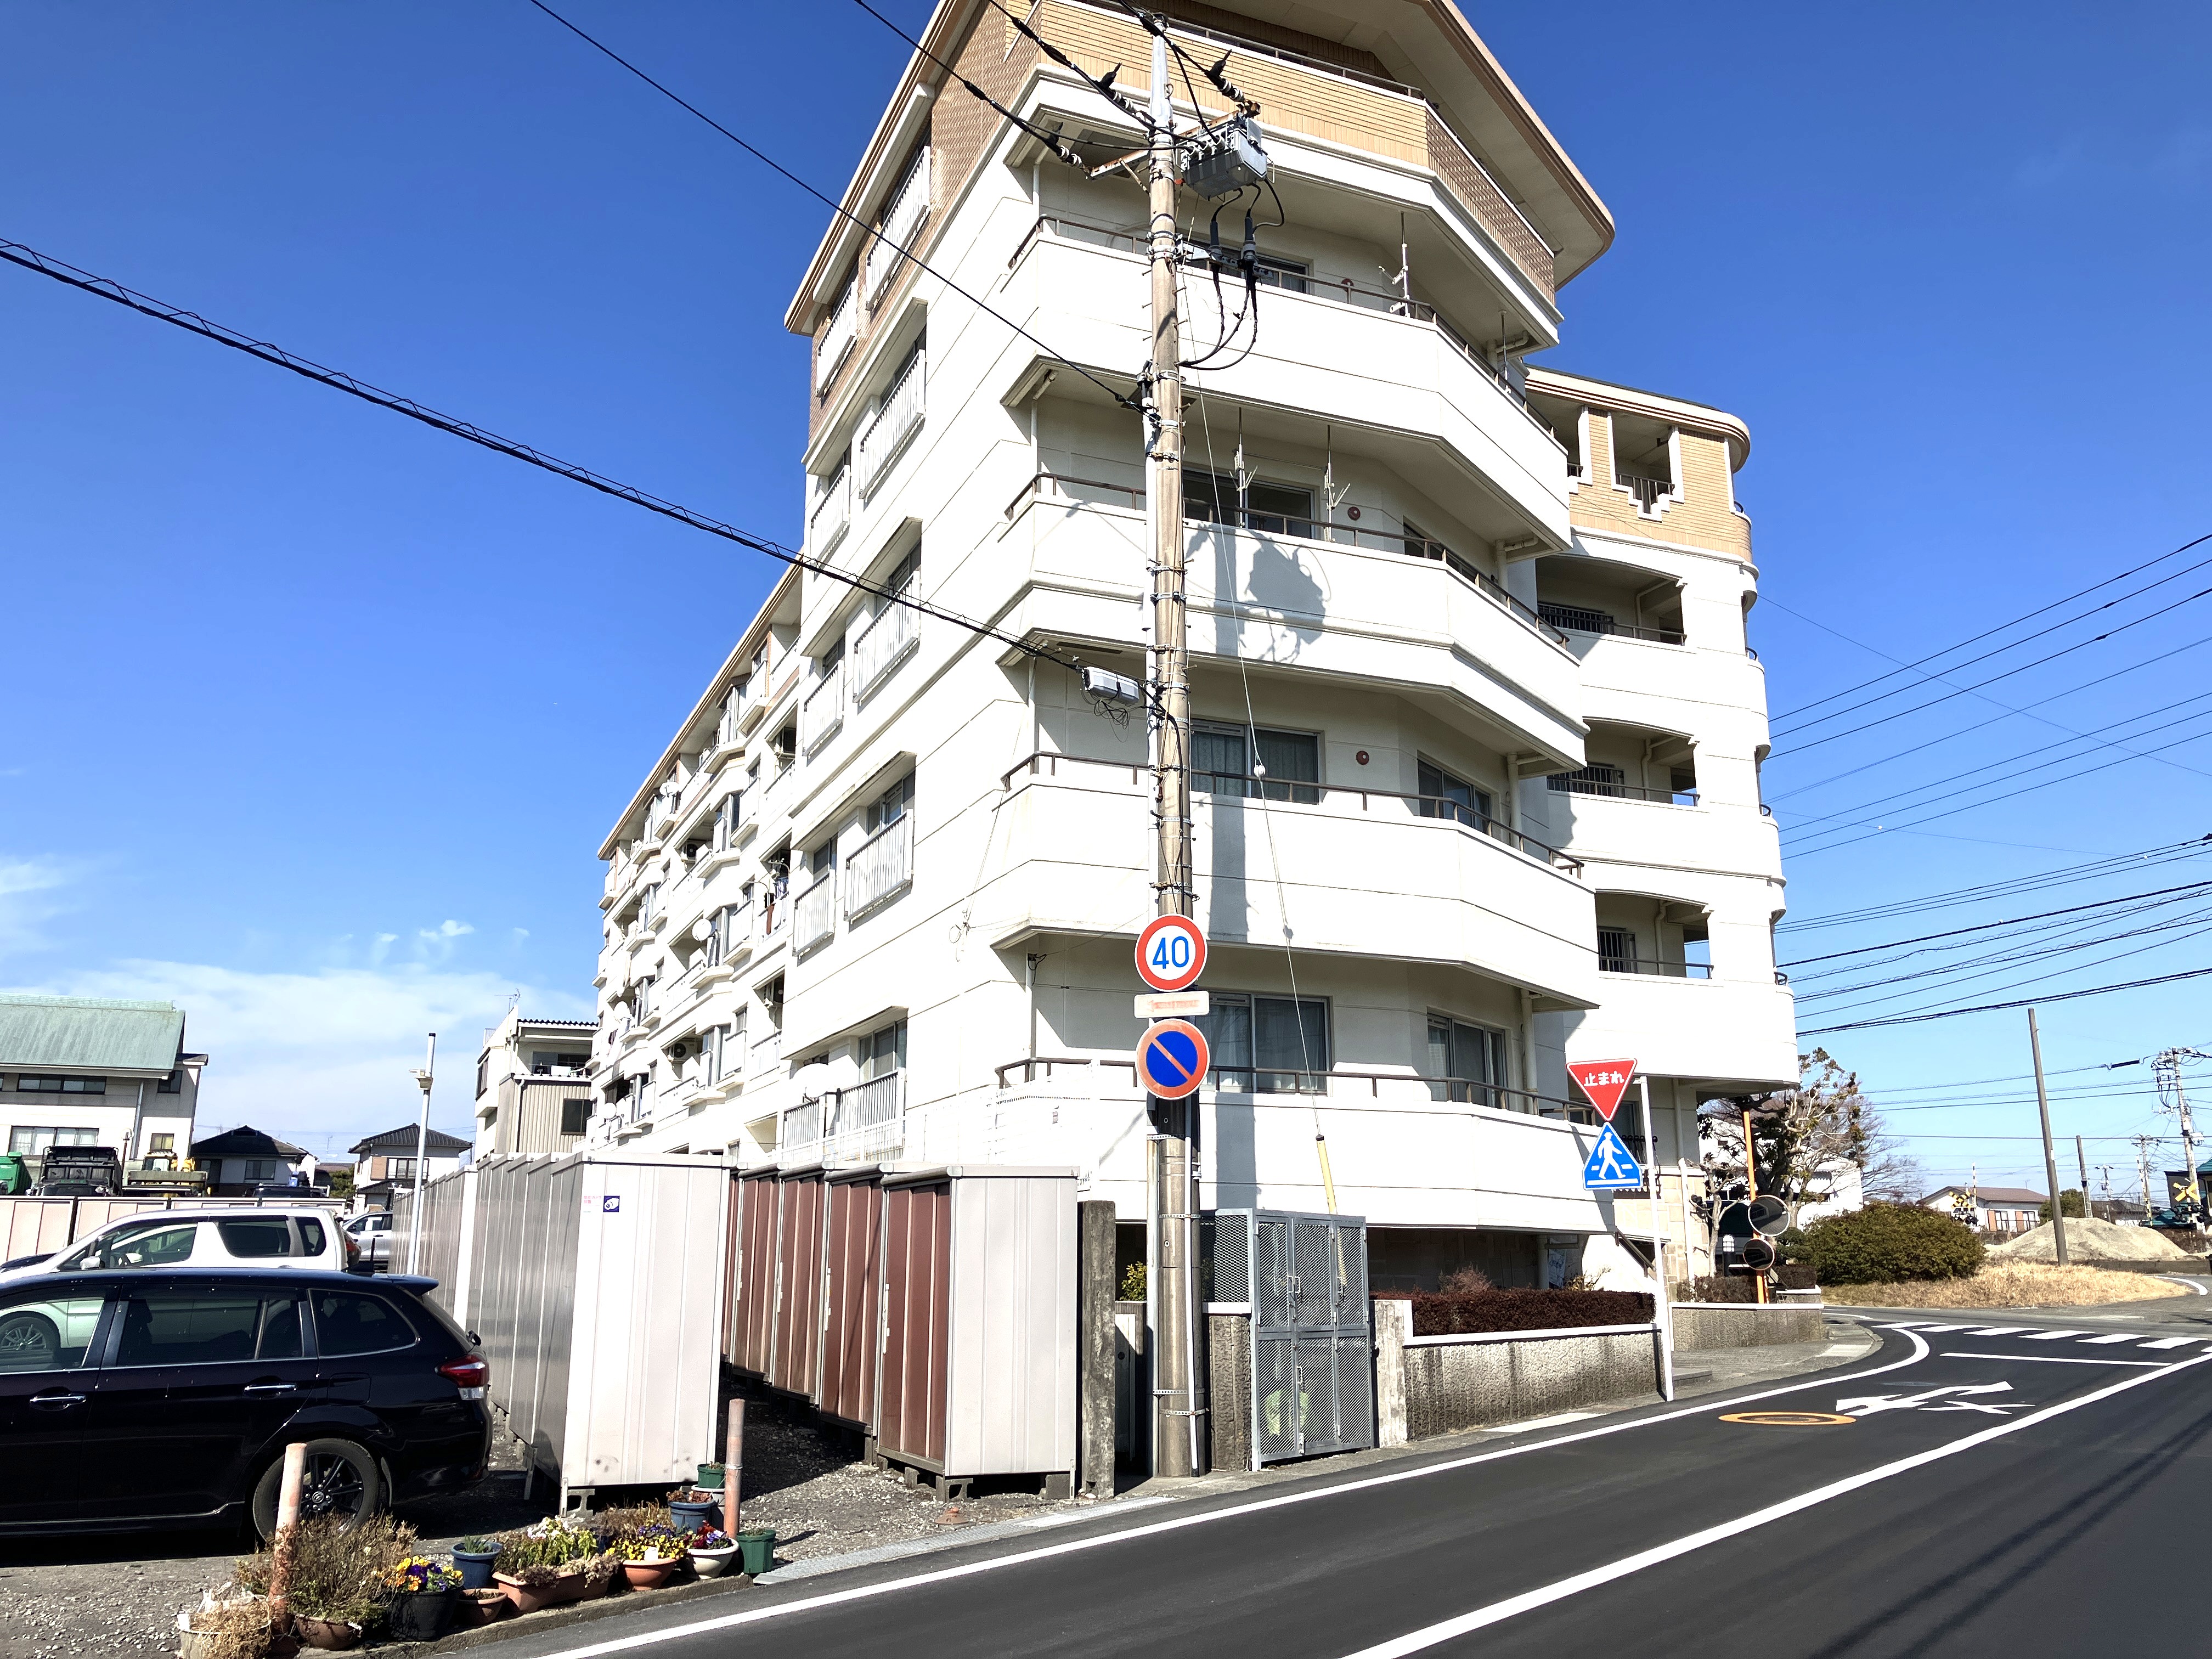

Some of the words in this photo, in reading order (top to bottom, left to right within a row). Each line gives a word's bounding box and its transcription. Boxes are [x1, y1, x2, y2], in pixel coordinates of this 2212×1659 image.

[1153, 936, 1189, 969] 40
[1584, 1070, 1624, 1086] 止まれ
